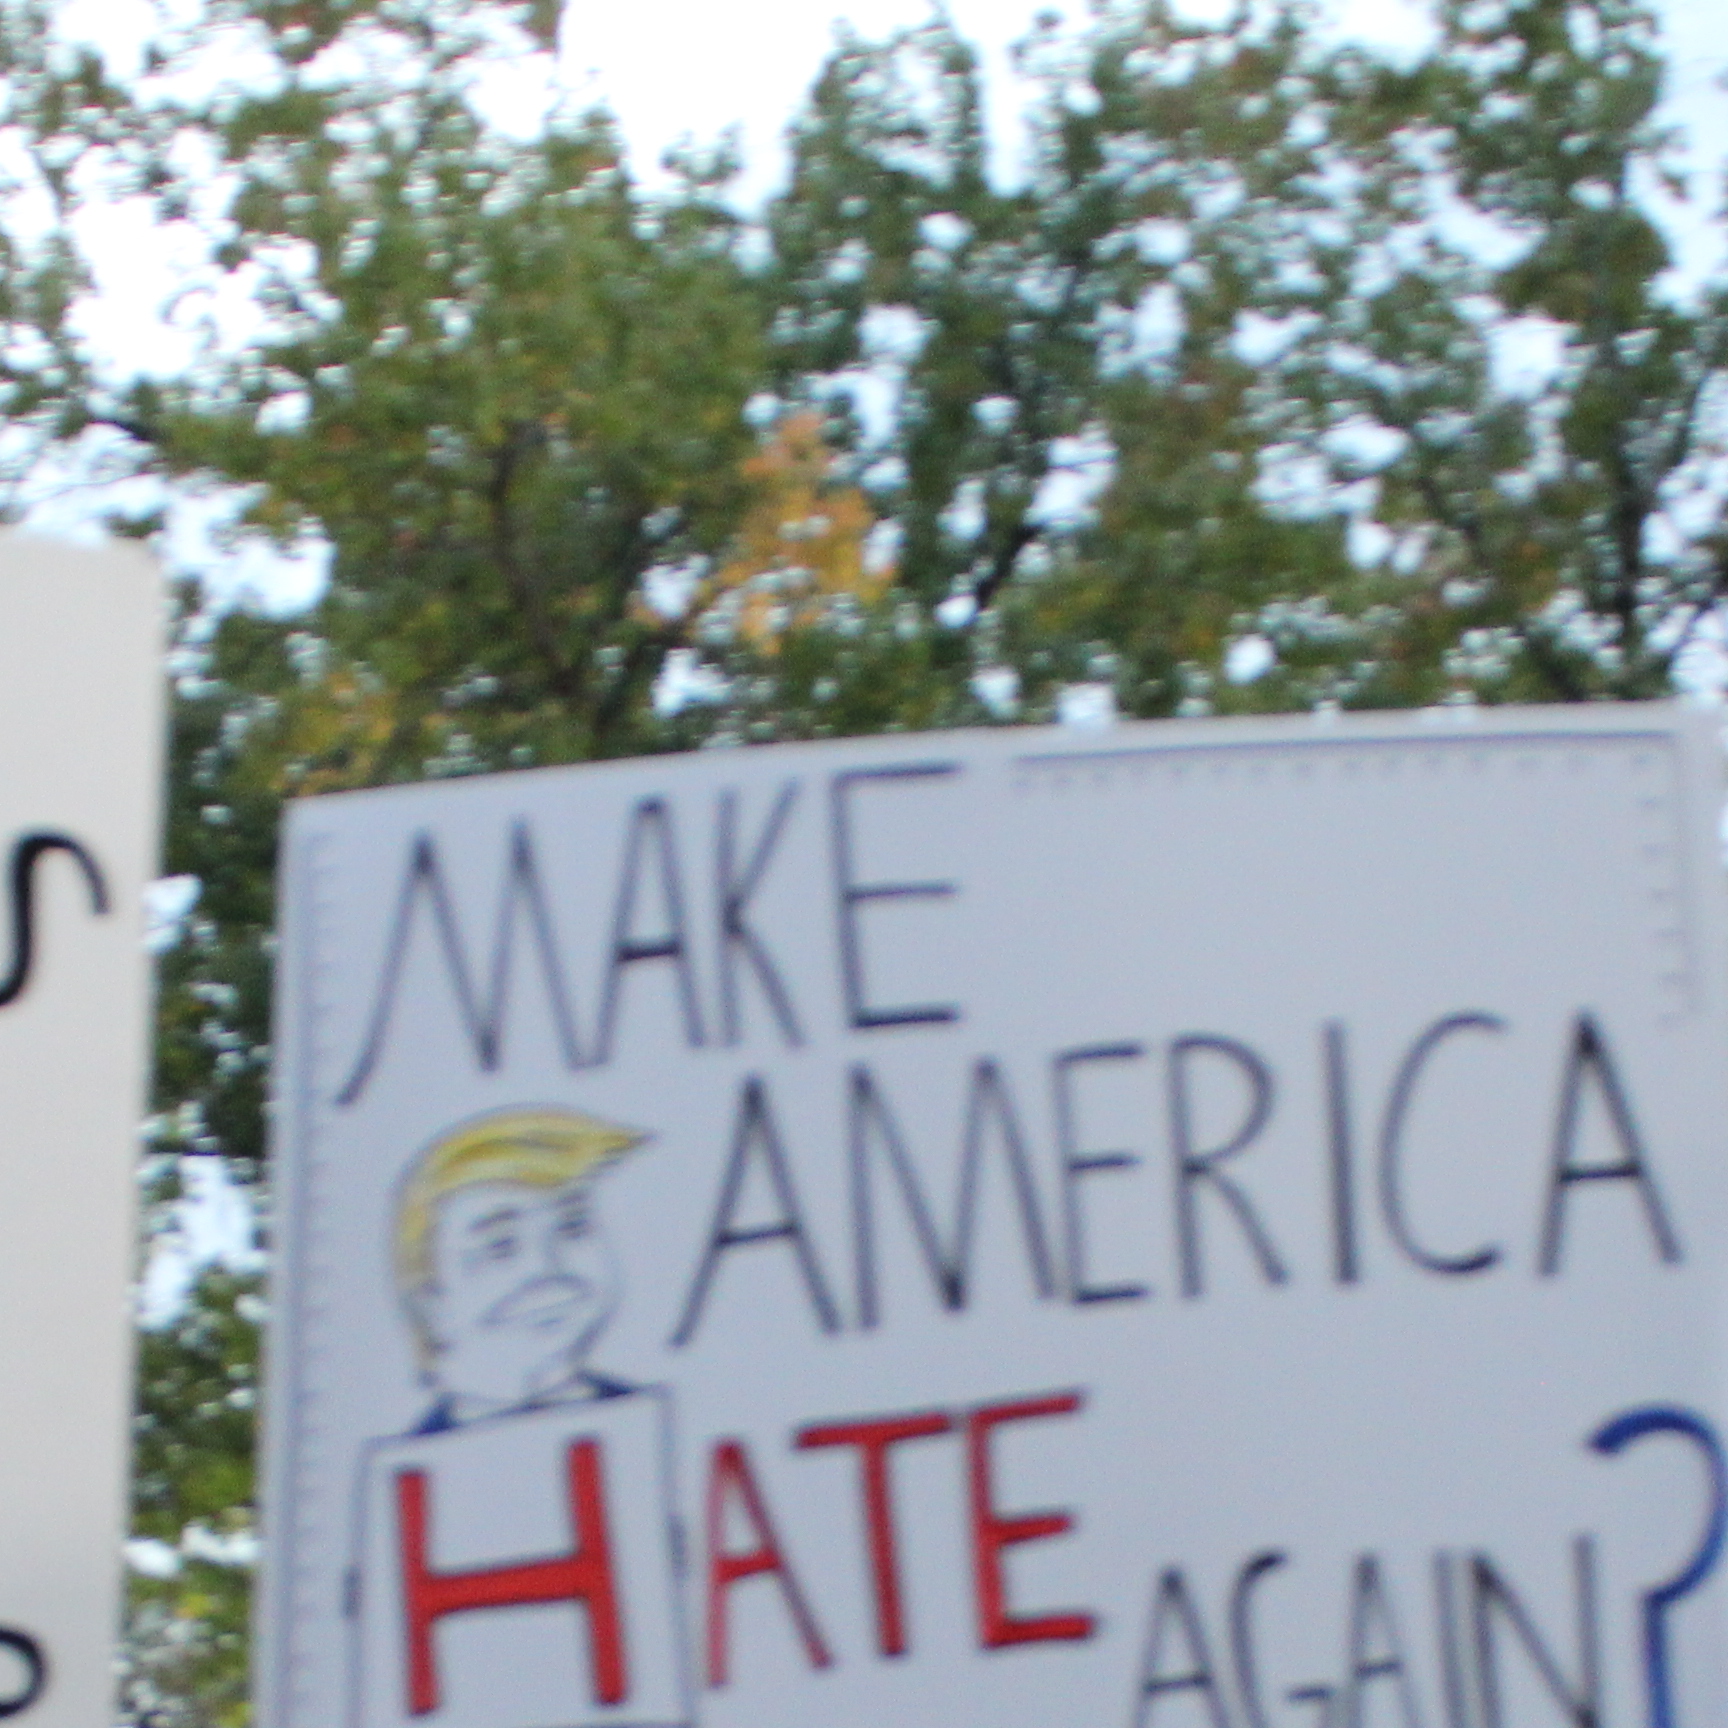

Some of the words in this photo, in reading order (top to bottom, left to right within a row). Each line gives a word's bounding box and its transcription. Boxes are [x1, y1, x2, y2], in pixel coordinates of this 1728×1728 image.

[333, 762, 960, 1106] MAKE
[668, 1008, 1683, 1349] AMERICA
[396, 1392, 1097, 1718] HATE
